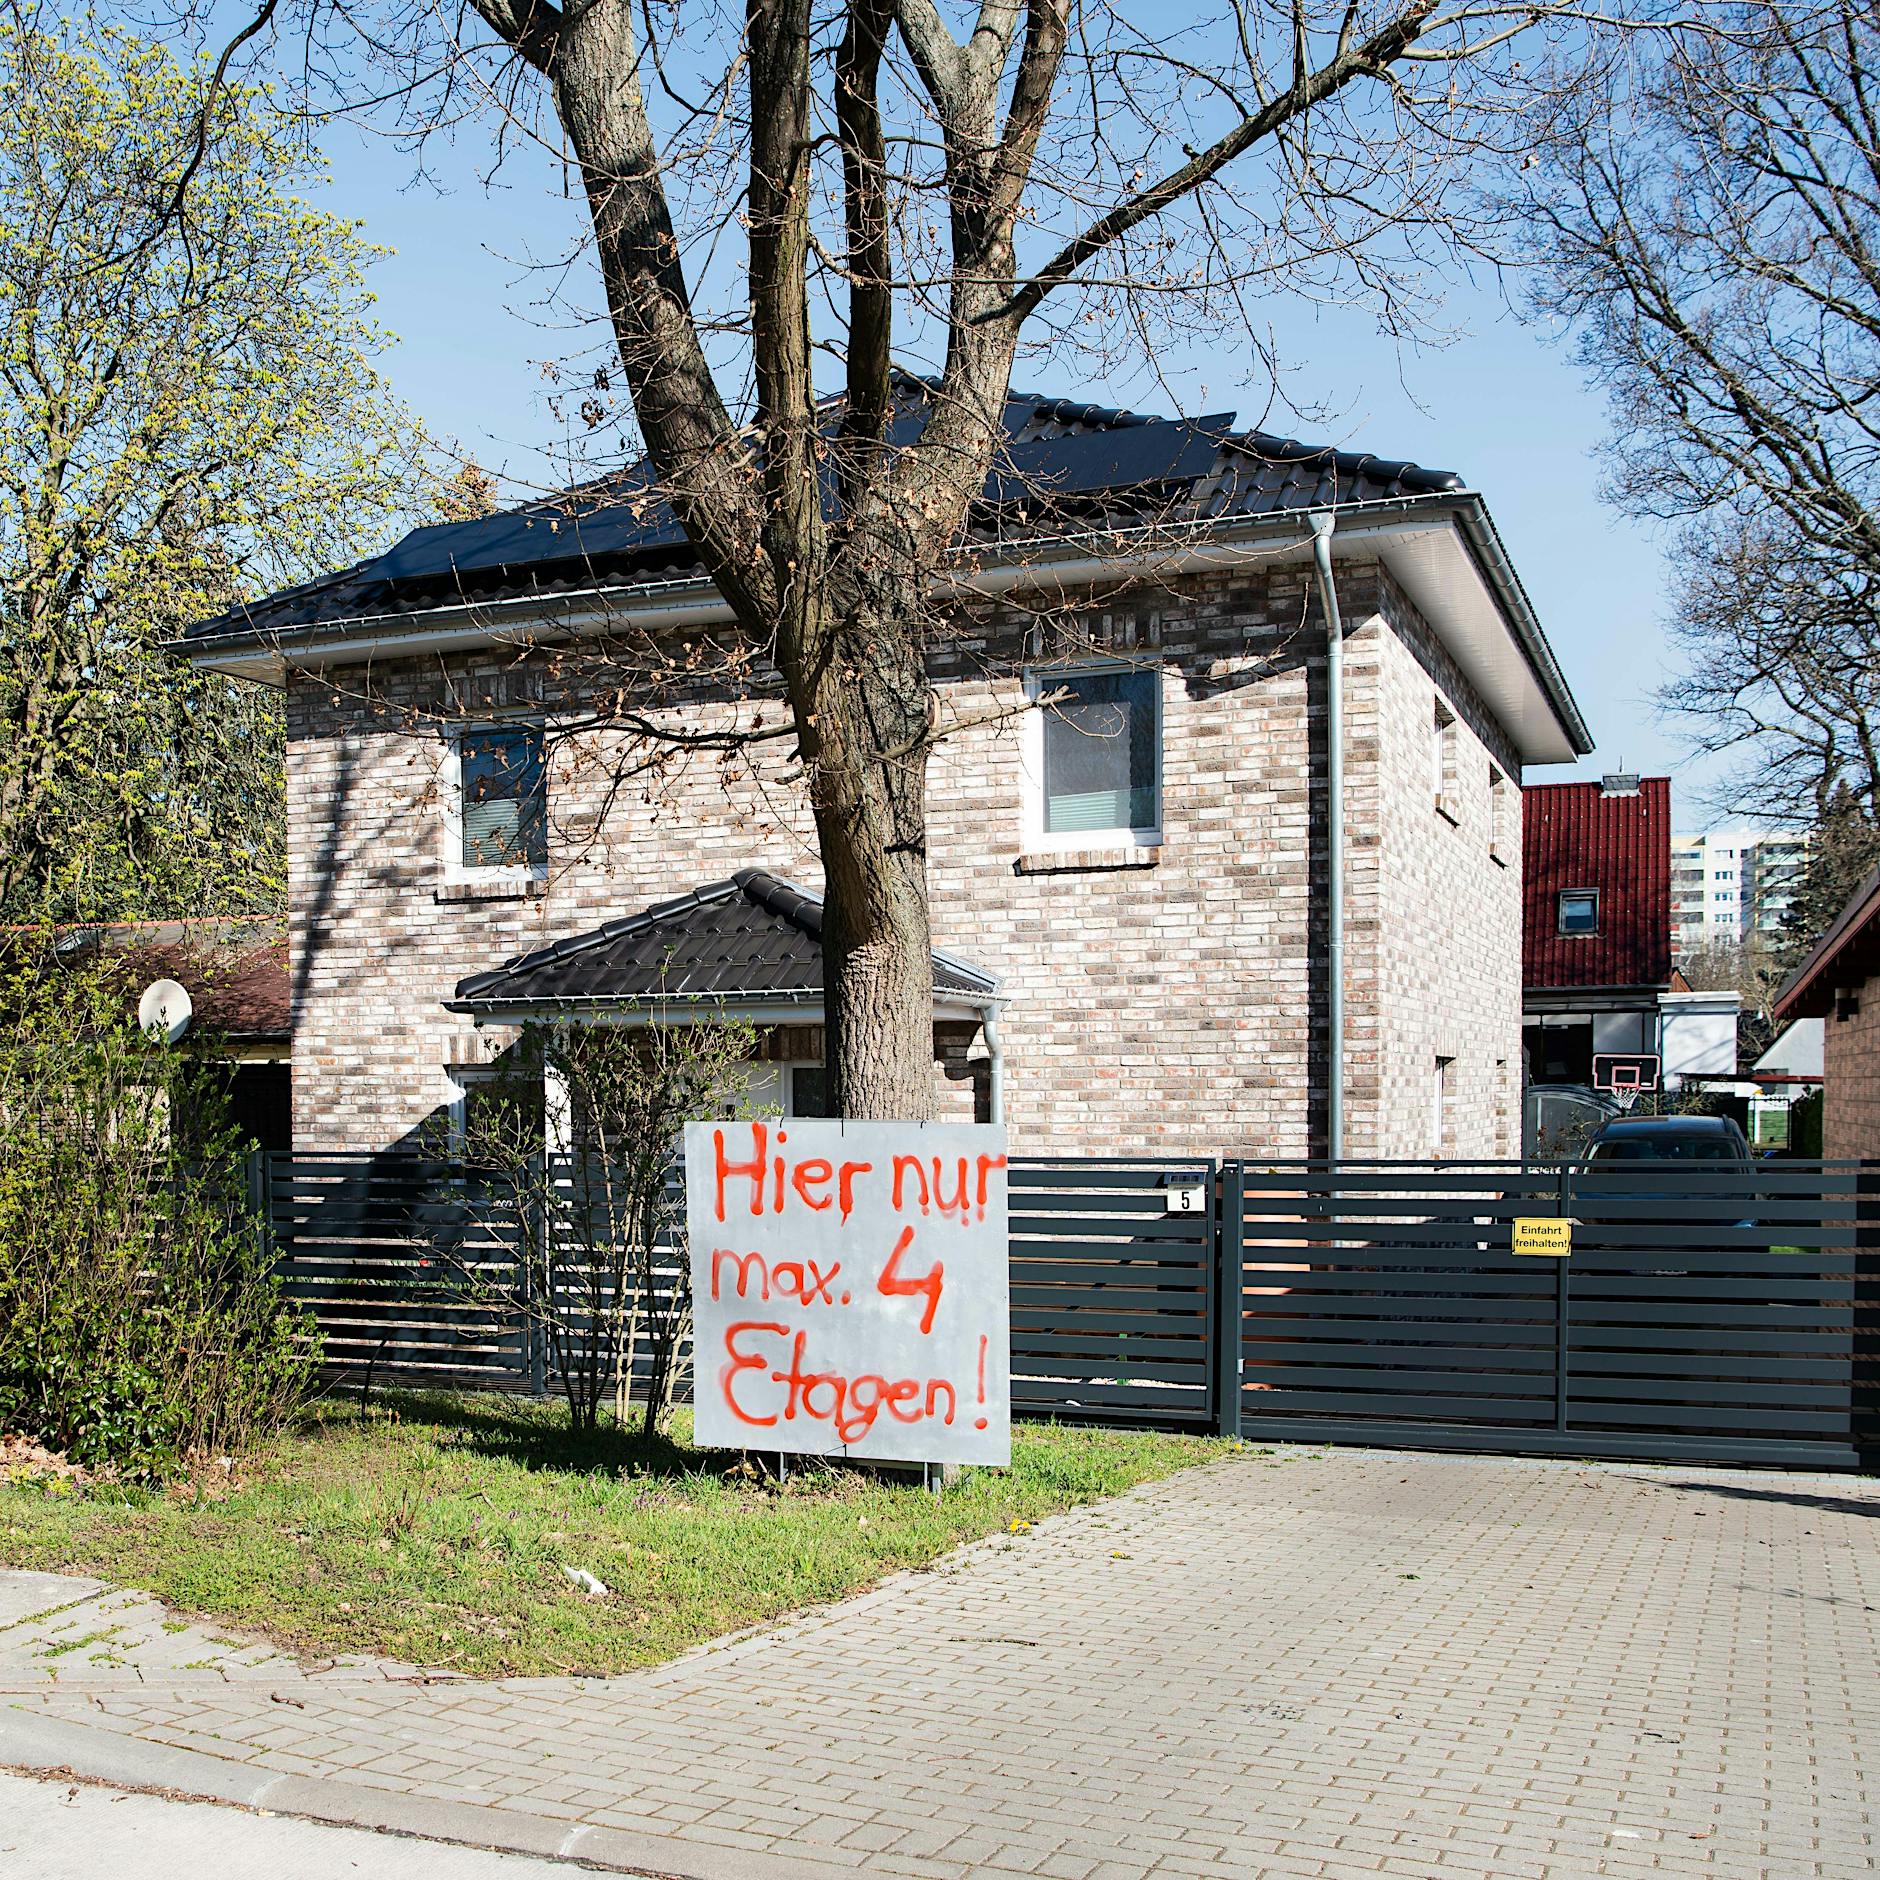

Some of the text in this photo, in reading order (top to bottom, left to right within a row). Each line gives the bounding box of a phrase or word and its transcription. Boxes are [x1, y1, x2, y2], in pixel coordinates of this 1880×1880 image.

[713, 1122, 1007, 1227] Hier nur
[1181, 1191, 1190, 1210] 5
[1521, 1225, 1562, 1235] Einfahrt
[1515, 1238, 1567, 1248] freihalten!
[711, 1225, 945, 1335] max. 4
